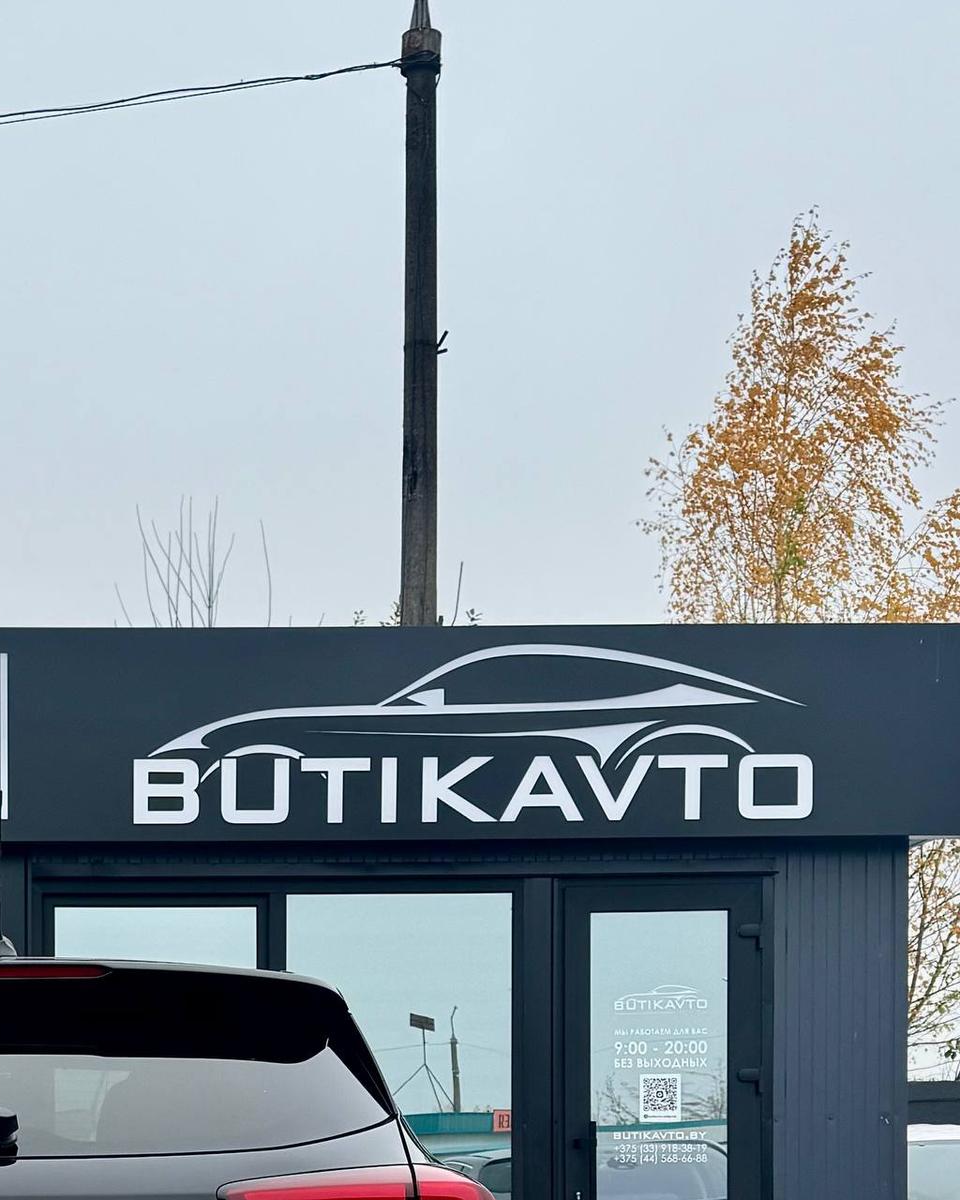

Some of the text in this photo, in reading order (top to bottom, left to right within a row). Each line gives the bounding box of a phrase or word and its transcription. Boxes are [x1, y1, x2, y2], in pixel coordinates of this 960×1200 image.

[132, 754, 814, 825] BUTIKAVTO
[614, 999, 708, 1011] BUTIKAVTO
[614, 1040, 648, 1056] 9:00
[663, 1040, 708, 1055] 20:00
[614, 1057, 708, 1069] БЕЗ ВЫХОДНЫХ
[613, 1131, 707, 1140] BUTIKAVTO.BY
[614, 1144, 637, 1153] +375
[639, 1143, 658, 1155] (33)
[614, 1154, 708, 1165] +375 (44) 568-66-88
